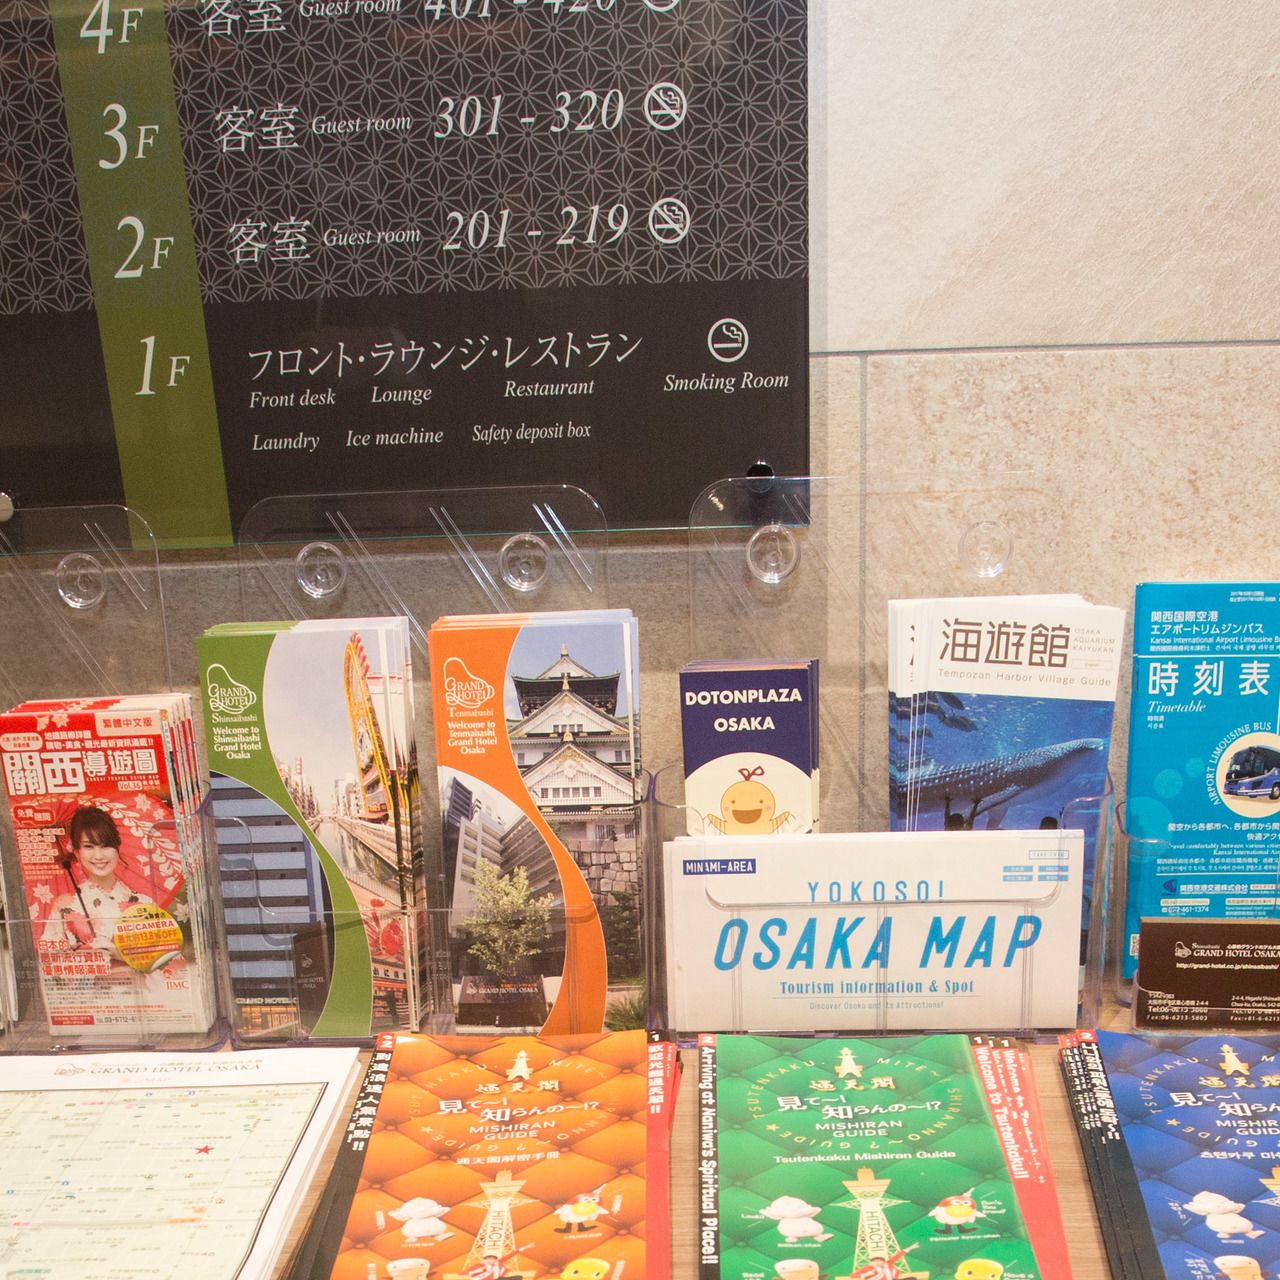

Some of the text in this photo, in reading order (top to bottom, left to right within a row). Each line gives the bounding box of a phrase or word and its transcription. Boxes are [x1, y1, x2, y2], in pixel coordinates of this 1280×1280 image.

[98, 89, 625, 170] 3F 客室 Guest room 301 320
[114, 203, 629, 279] 2F 客室 Guest room 201 219
[135, 335, 191, 396] 1F
[663, 371, 790, 395] Smoking Room
[249, 379, 595, 409] Front desk Lounge Restaurant
[252, 421, 591, 452] Laundry Ice machine Safety deposit box
[1151, 610, 1219, 623] 関西国際空港
[1150, 623, 1264, 635] エアポートリムジンバス
[939, 617, 1070, 669] 海遊館
[1150, 636, 1172, 644] Kansai
[1215, 635, 1239, 645] Airport
[1240, 635, 1273, 643] Limousine
[938, 668, 1112, 686] Tempozan Harbor Village Guide
[1148, 660, 1271, 697] 時刻表
[685, 688, 802, 706] DOTONPLAZA
[1147, 700, 1206, 712] Timetable
[212, 726, 248, 735] Welcome
[447, 721, 485, 729] Welcome
[714, 716, 775, 732] OSAKA
[213, 734, 260, 743] Shinsaibashi
[449, 729, 495, 737] Tenmabashi
[214, 742, 261, 751] Grand Hotel
[448, 737, 497, 746] Grand Hotel
[1211, 723, 1251, 767] LIMOUSINE
[1253, 722, 1272, 731] BUS
[226, 751, 250, 760] Osaka
[460, 746, 485, 754] Osaka
[685, 860, 754, 874] MINAMI-AREA
[808, 880, 945, 903] YOKOSO!
[135, 921, 174, 930] CAMERA
[713, 914, 1043, 971] OSAKA MAP
[1225, 950, 1253, 958] HOTEL
[780, 979, 974, 994] Tourism & Spot
[90, 1063, 262, 1074] GRAND HOTEL OSAKA
[976, 1046, 1030, 1179] Welcome to Tsutenkaku!!
[470, 1120, 557, 1134] MISHIRAN
[815, 1120, 903, 1131] MISHIRAN
[483, 1130, 539, 1141] GUIDE
[832, 1128, 889, 1138] GUIDE
[698, 1046, 719, 1264] Arriving at Naniwa's Spiritual Place!!
[773, 1149, 957, 1164] Tsutenkaku Mishiran Guide
[489, 1210, 505, 1252] HITACHI
[865, 1210, 883, 1252] HITACHI
